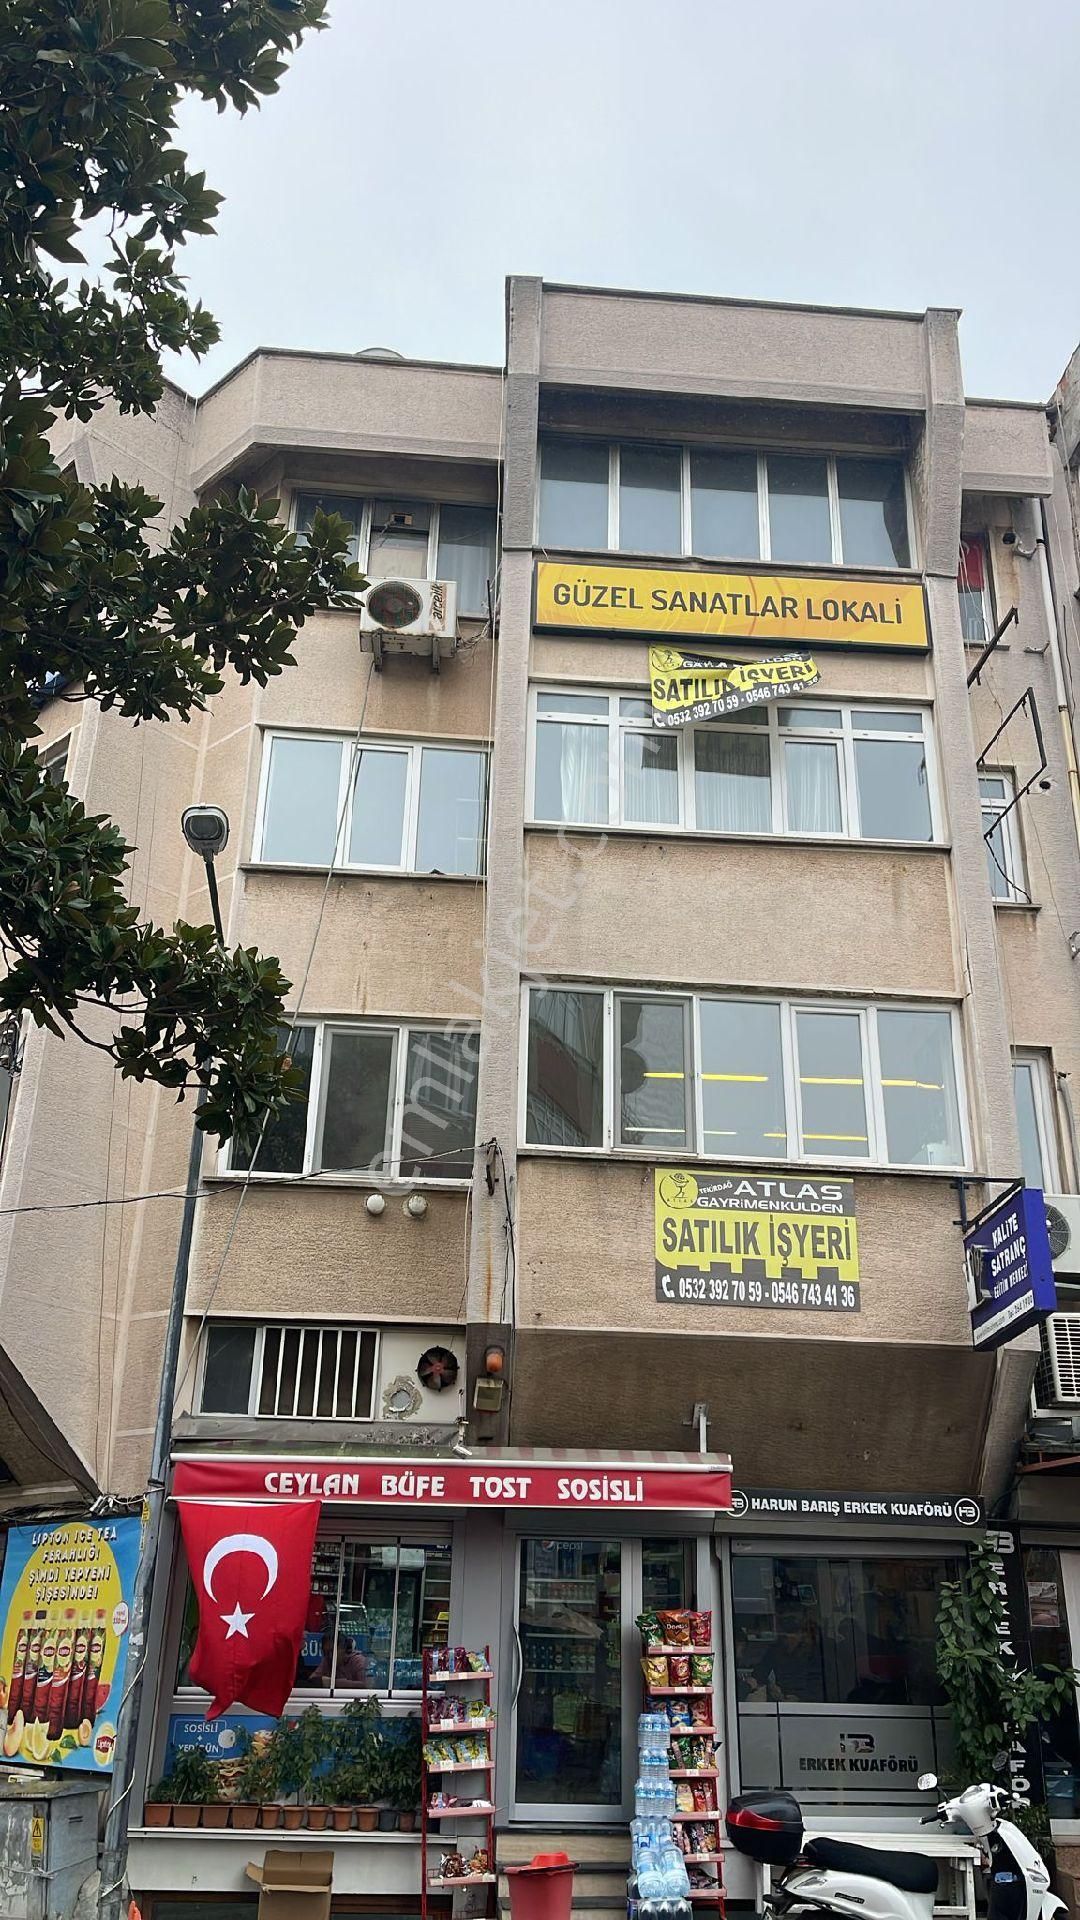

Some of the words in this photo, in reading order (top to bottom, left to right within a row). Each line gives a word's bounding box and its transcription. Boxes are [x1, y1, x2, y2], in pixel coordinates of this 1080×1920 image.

[553, 579, 643, 610] GÜZEL
[651, 589, 799, 619] SANATLAR
[806, 597, 903, 625] LOKALİ
[668, 709, 691, 726] 0532
[693, 704, 711, 719] 392
[712, 699, 725, 713] 70
[727, 695, 739, 710] 59
[746, 687, 770, 703] 0546
[772, 683, 790, 696] 743
[793, 681, 804, 692] 41
[734, 1180, 842, 1200] ATLAS
[662, 1218, 760, 1256] SATILIK
[769, 1215, 851, 1266] İŞYERİ
[992, 1213, 1018, 1248] KALİTE
[991, 1236, 1026, 1276] SATRANÇ
[679, 1280, 706, 1299] 0532
[709, 1280, 729, 1300] 392
[732, 1281, 745, 1301] 70
[748, 1282, 762, 1301] 59
[771, 1282, 799, 1304] 0546
[802, 1284, 821, 1305] 743
[825, 1285, 838, 1305] 41
[841, 1286, 855, 1307] 36
[265, 1473, 359, 1496] CEYLAN
[381, 1471, 445, 1499] BÜFE
[469, 1477, 531, 1499] TOST
[558, 1476, 643, 1501] SOSİSLİ
[752, 1498, 797, 1511] HARUN
[802, 1500, 840, 1516] BARIŞ
[844, 1502, 888, 1515] ERKEK
[891, 1501, 951, 1516] KUAFÖRÜ
[32, 1531, 69, 1546] LIPTON
[98, 1526, 117, 1542] TEA
[64, 1564, 111, 1582] YEPYENİ
[800, 1758, 846, 1771] ERKEK
[849, 1755, 918, 1772] KUAFÖRÜ
